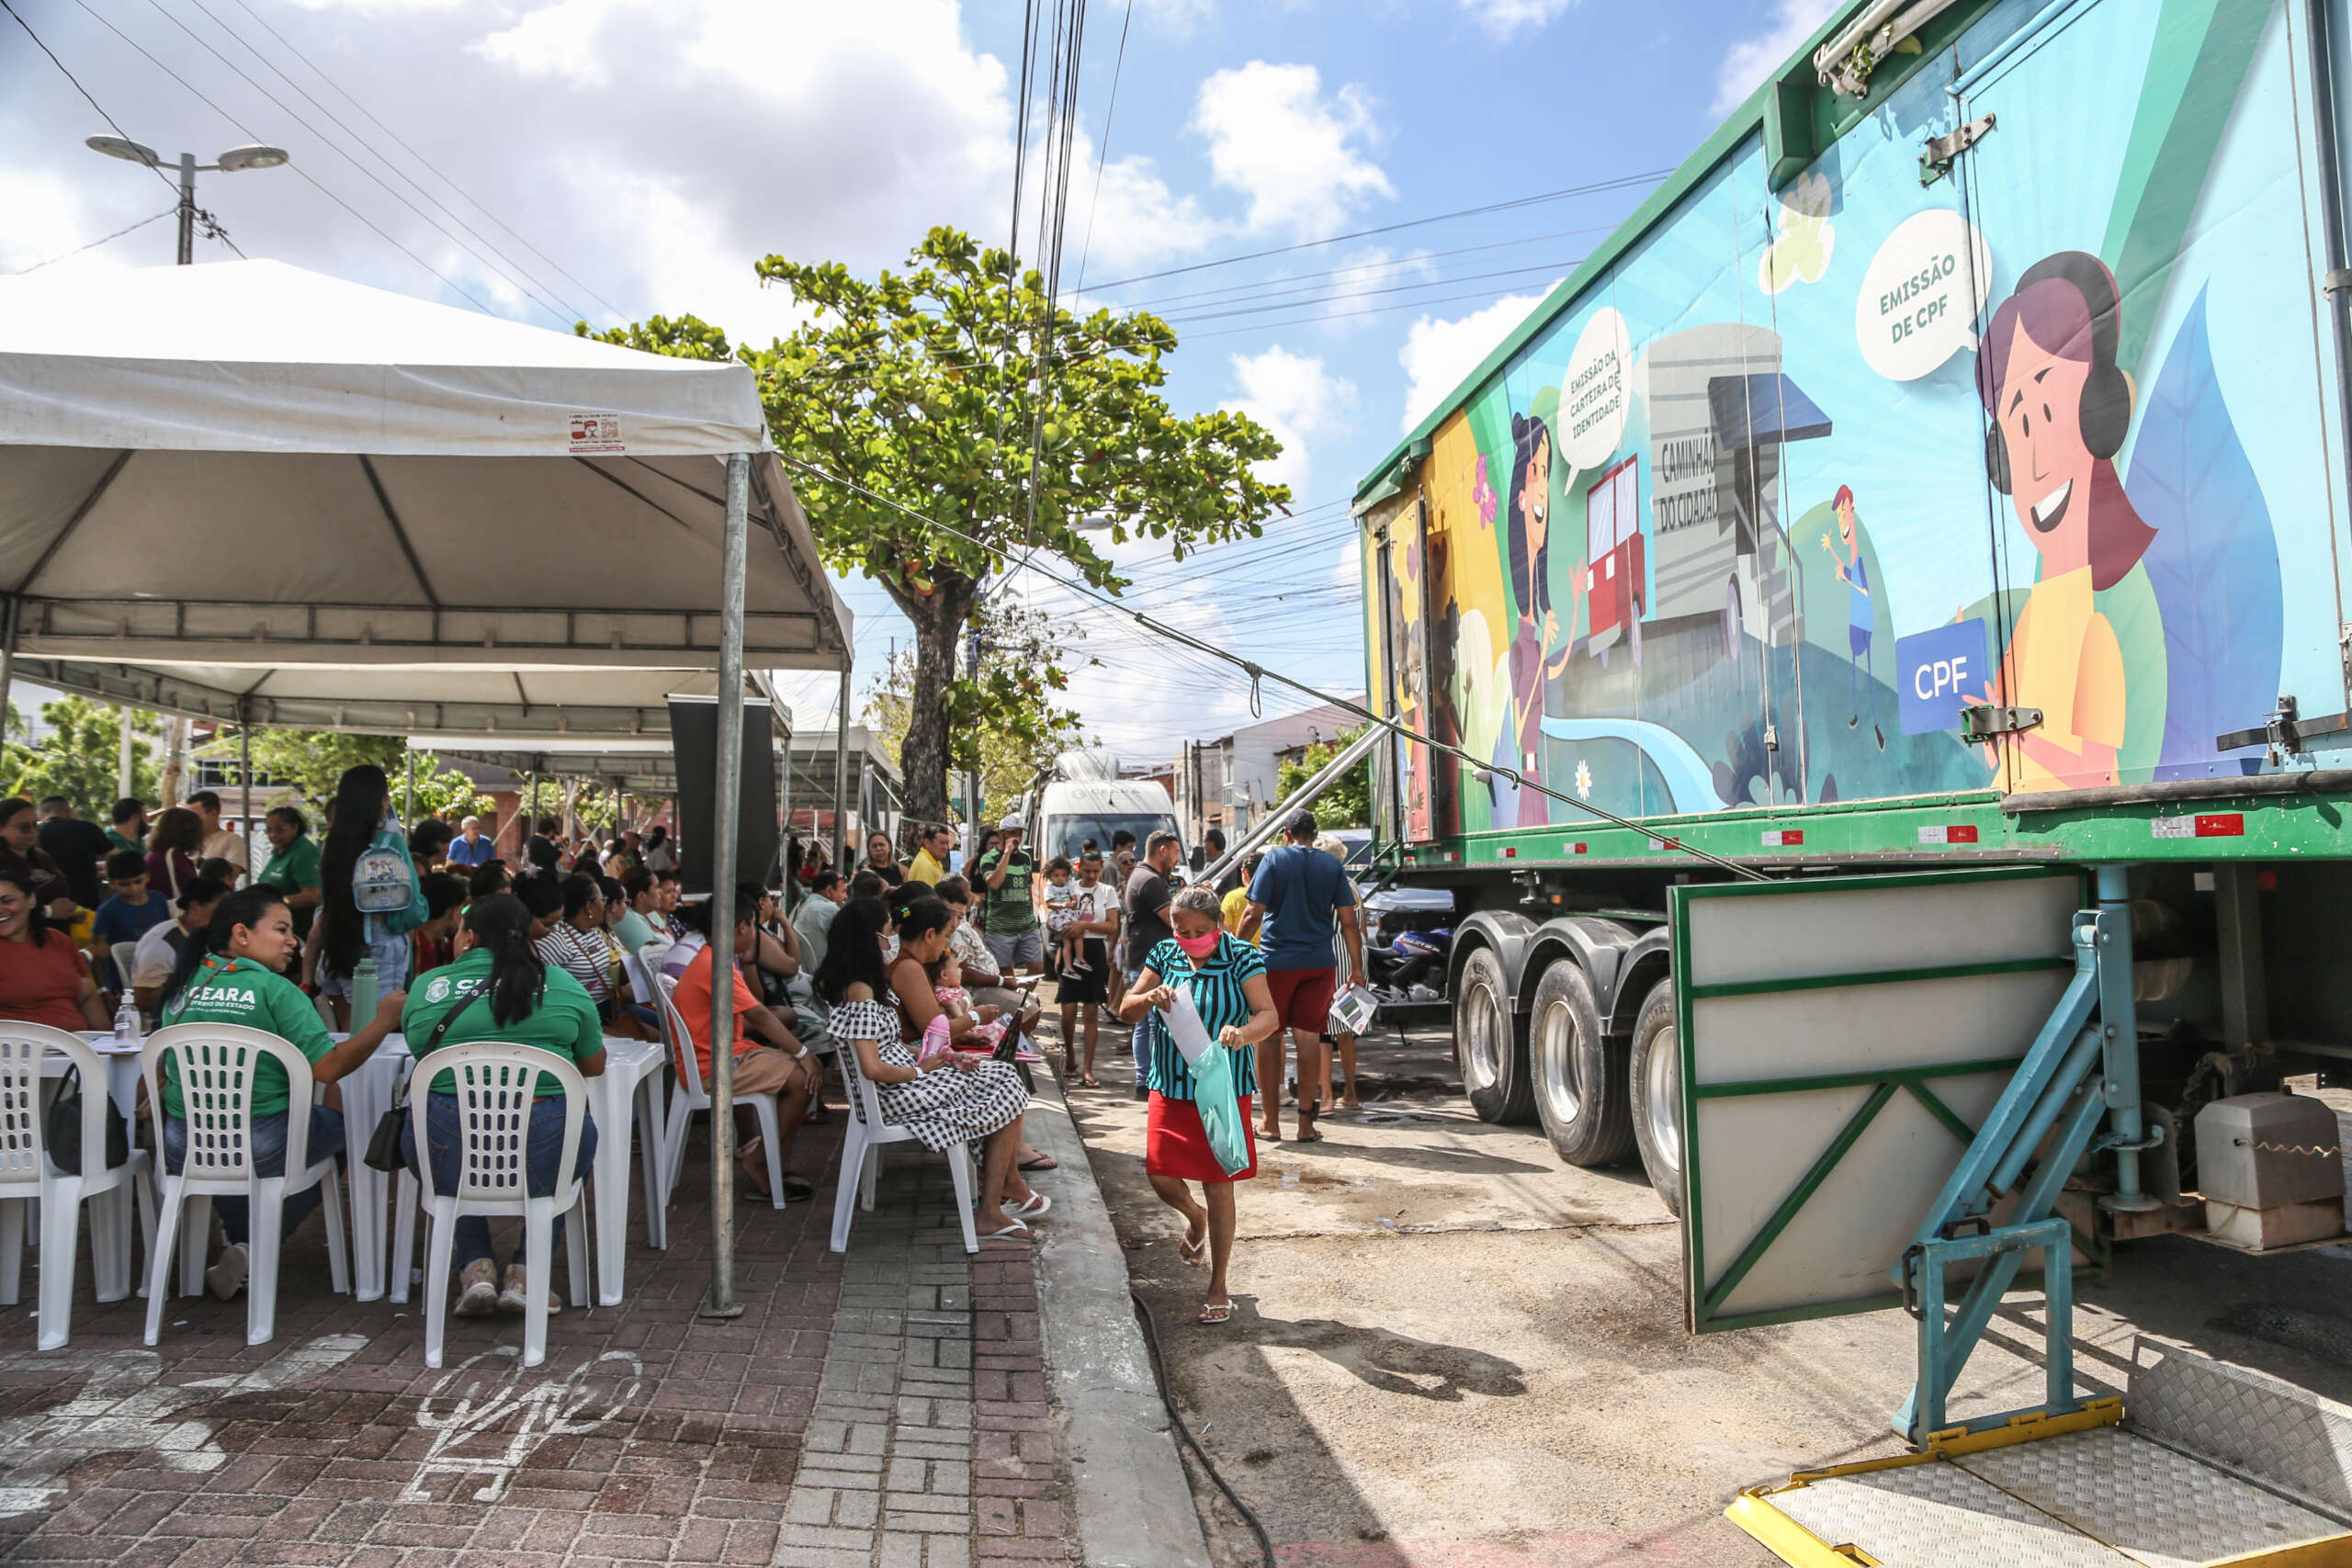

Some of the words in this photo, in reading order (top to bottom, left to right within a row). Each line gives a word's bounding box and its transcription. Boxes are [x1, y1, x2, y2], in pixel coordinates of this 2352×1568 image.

[1880, 254, 1955, 316] EMISSÃO
[1892, 315, 1913, 344] DE
[1917, 294, 1948, 328] CPF
[1570, 358, 1603, 394] EMISSÃO
[1604, 349, 1617, 368] DA
[1570, 381, 1608, 417] CARTEIRA
[1608, 371, 1620, 389] DE
[1573, 395, 1620, 439] IDENTIDADE
[1662, 427, 1716, 483] CAMINHÃO
[1659, 496, 1676, 533] DO
[1678, 479, 1719, 528] CIDADÃO
[1915, 656, 1967, 700] CPF
